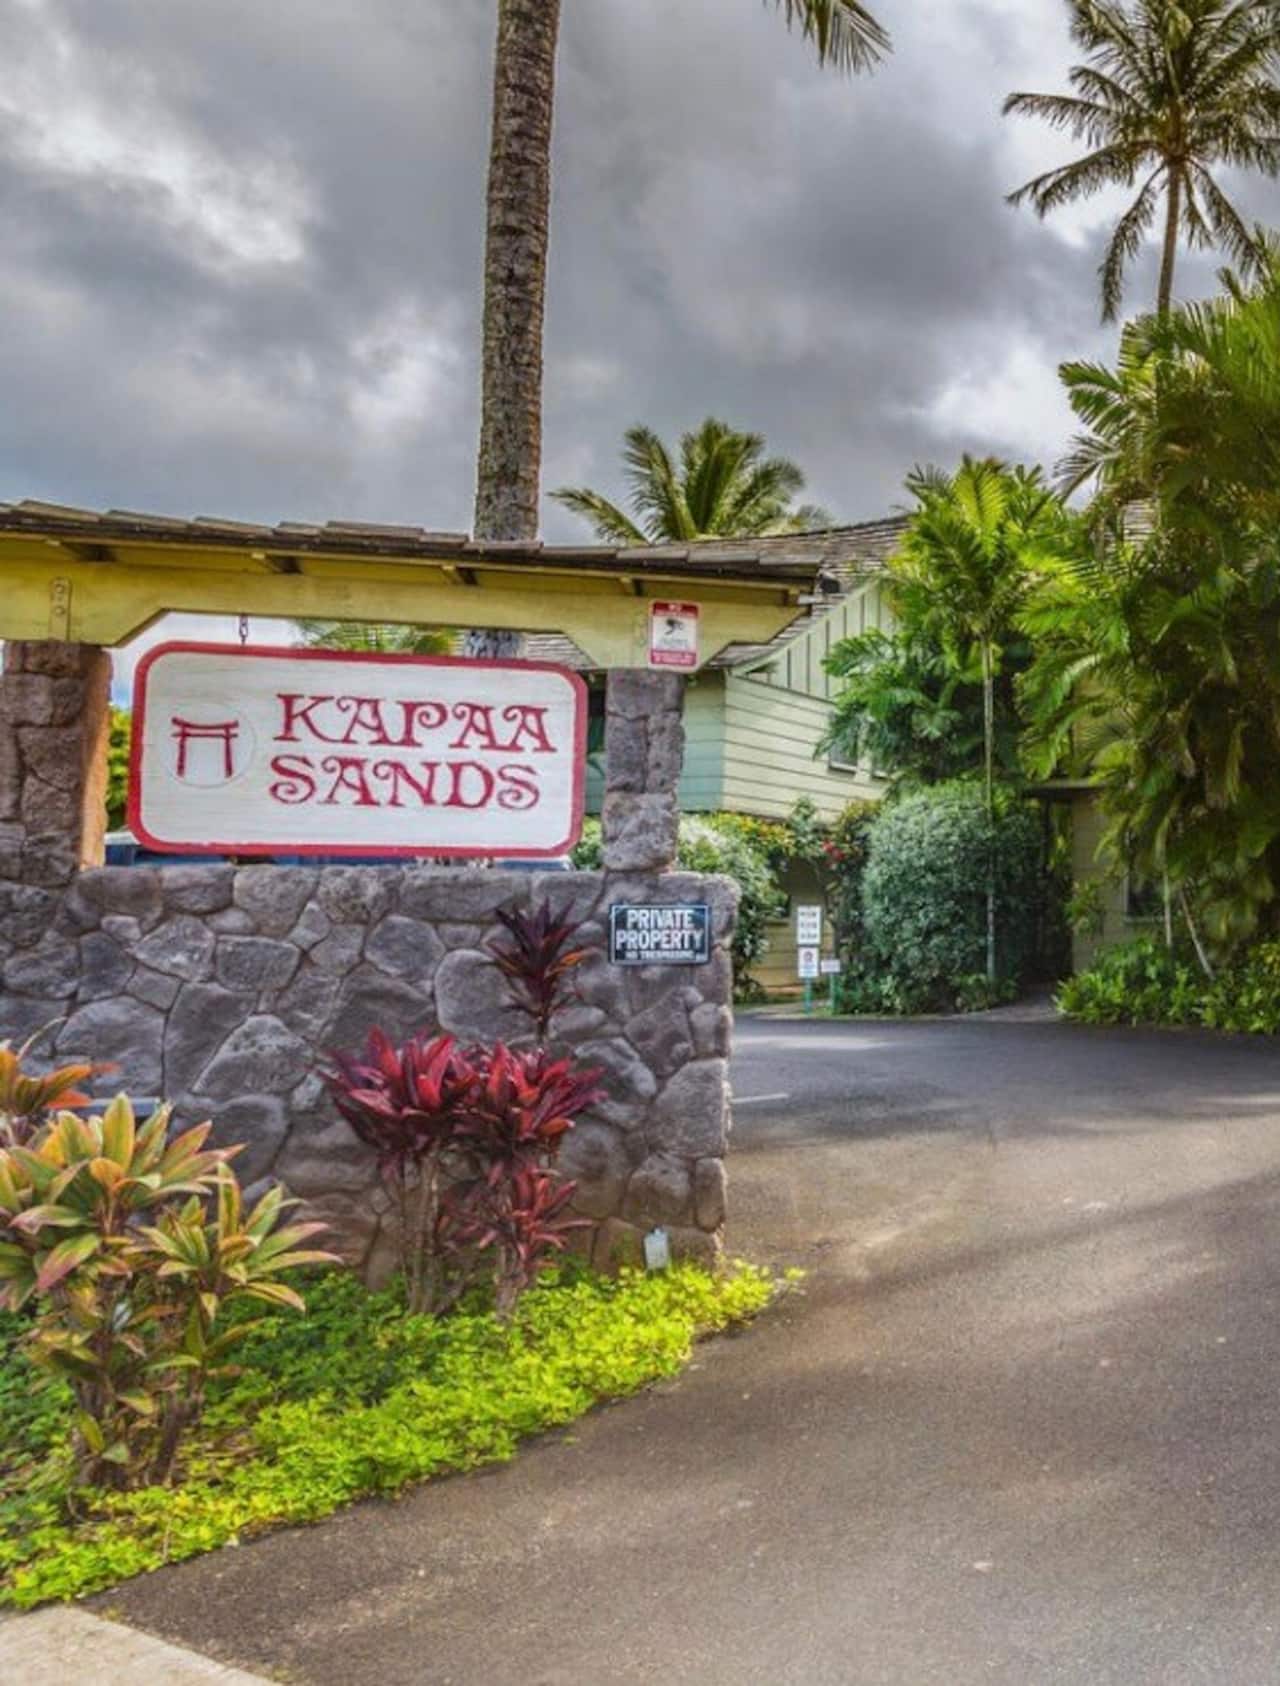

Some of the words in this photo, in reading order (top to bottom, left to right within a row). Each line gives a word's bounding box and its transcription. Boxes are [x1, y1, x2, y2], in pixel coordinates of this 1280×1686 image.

[272, 693, 558, 753] KAPAA
[269, 754, 540, 810] SANDS
[626, 909, 695, 929] PRIVATE
[615, 929, 704, 950] PROPERTY
